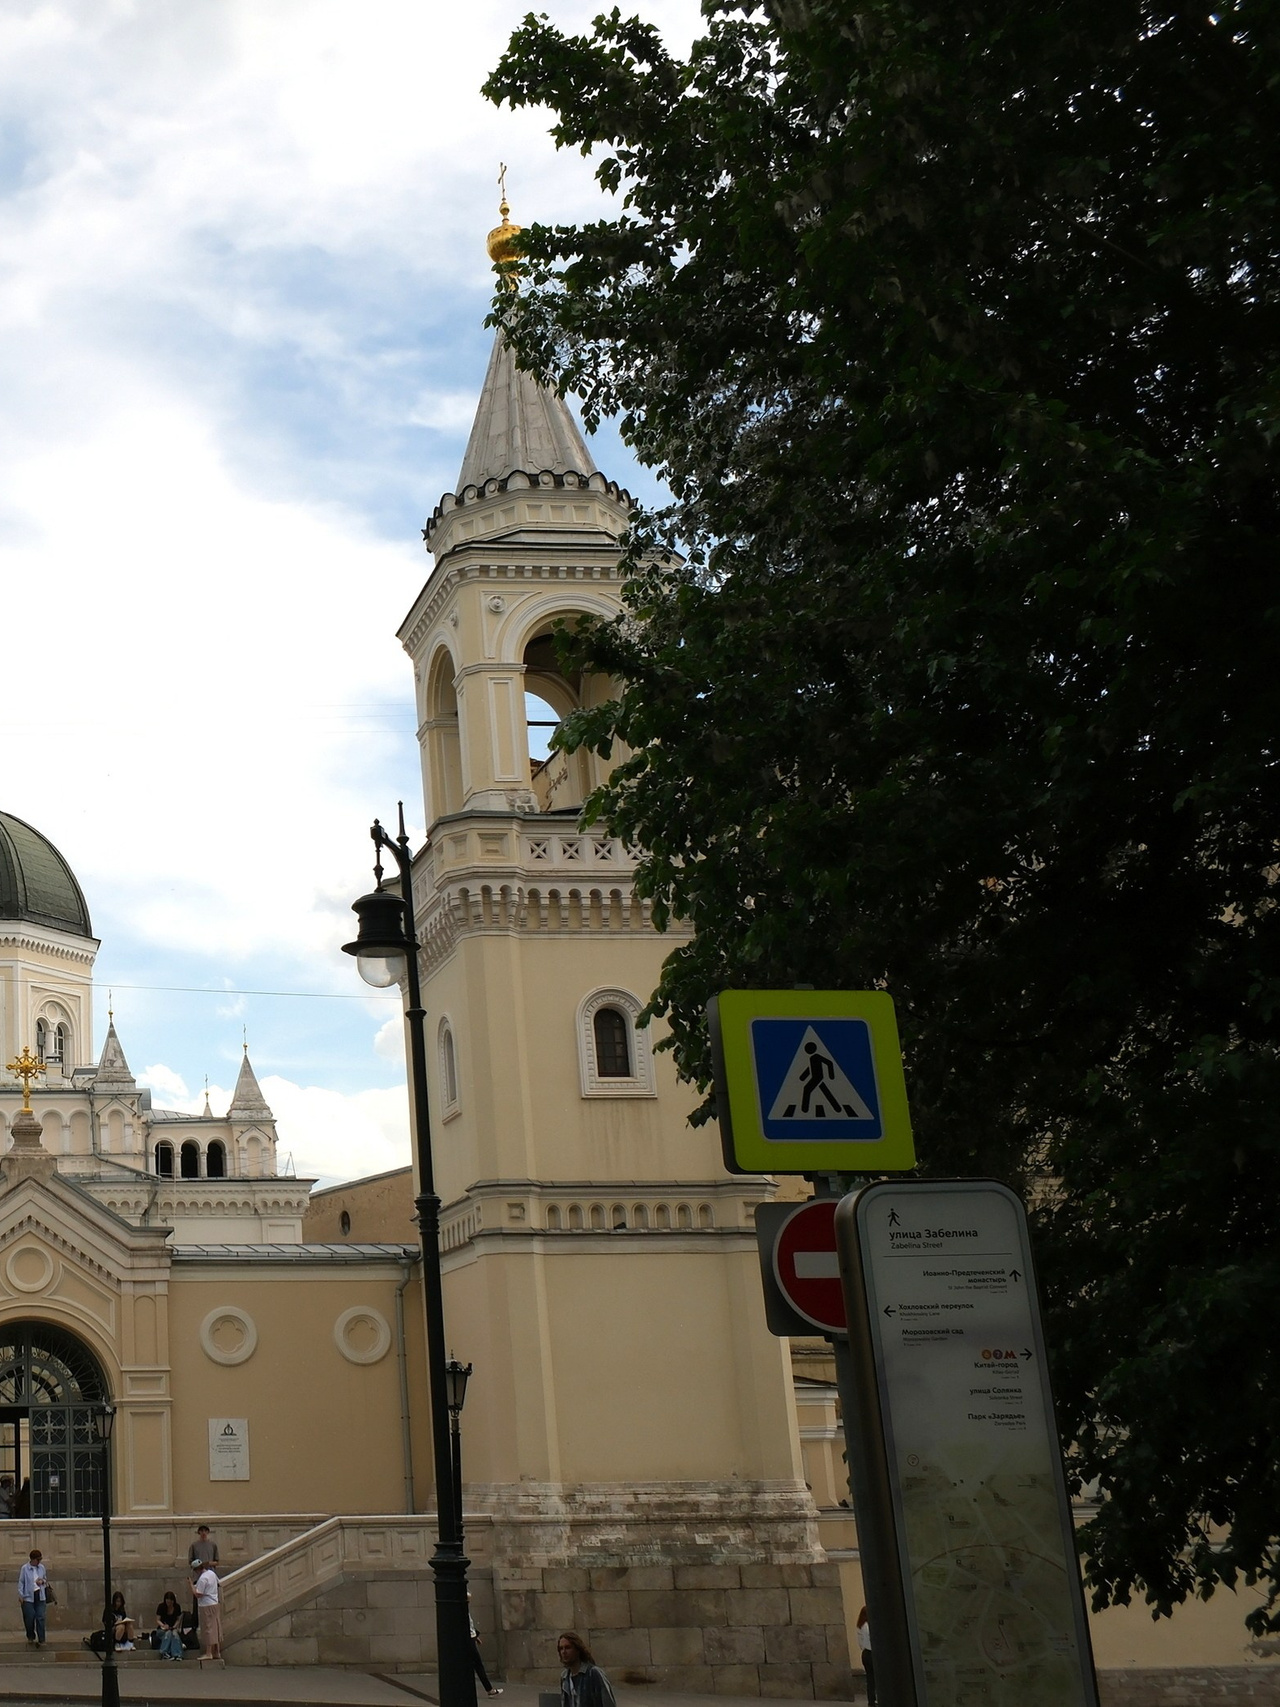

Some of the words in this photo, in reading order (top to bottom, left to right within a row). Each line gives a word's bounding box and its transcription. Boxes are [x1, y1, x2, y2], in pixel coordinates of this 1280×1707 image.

[889, 1230, 922, 1241] улица
[924, 1229, 978, 1239] Забелина
[891, 1242, 921, 1250] Zabelina
[922, 1241, 943, 1249] Street
[923, 1269, 1006, 1277] Иоанно-Предтеченский
[898, 1303, 940, 1311] Хохловский
[941, 1303, 974, 1311] переулок
[901, 1328, 950, 1336] Морозовский
[974, 1361, 1019, 1369] Китай-город
[969, 1388, 991, 1396] улица
[992, 1386, 1022, 1394] Солянка
[967, 1413, 987, 1421] Парк
[988, 1412, 1025, 1420] «Зарядье»
